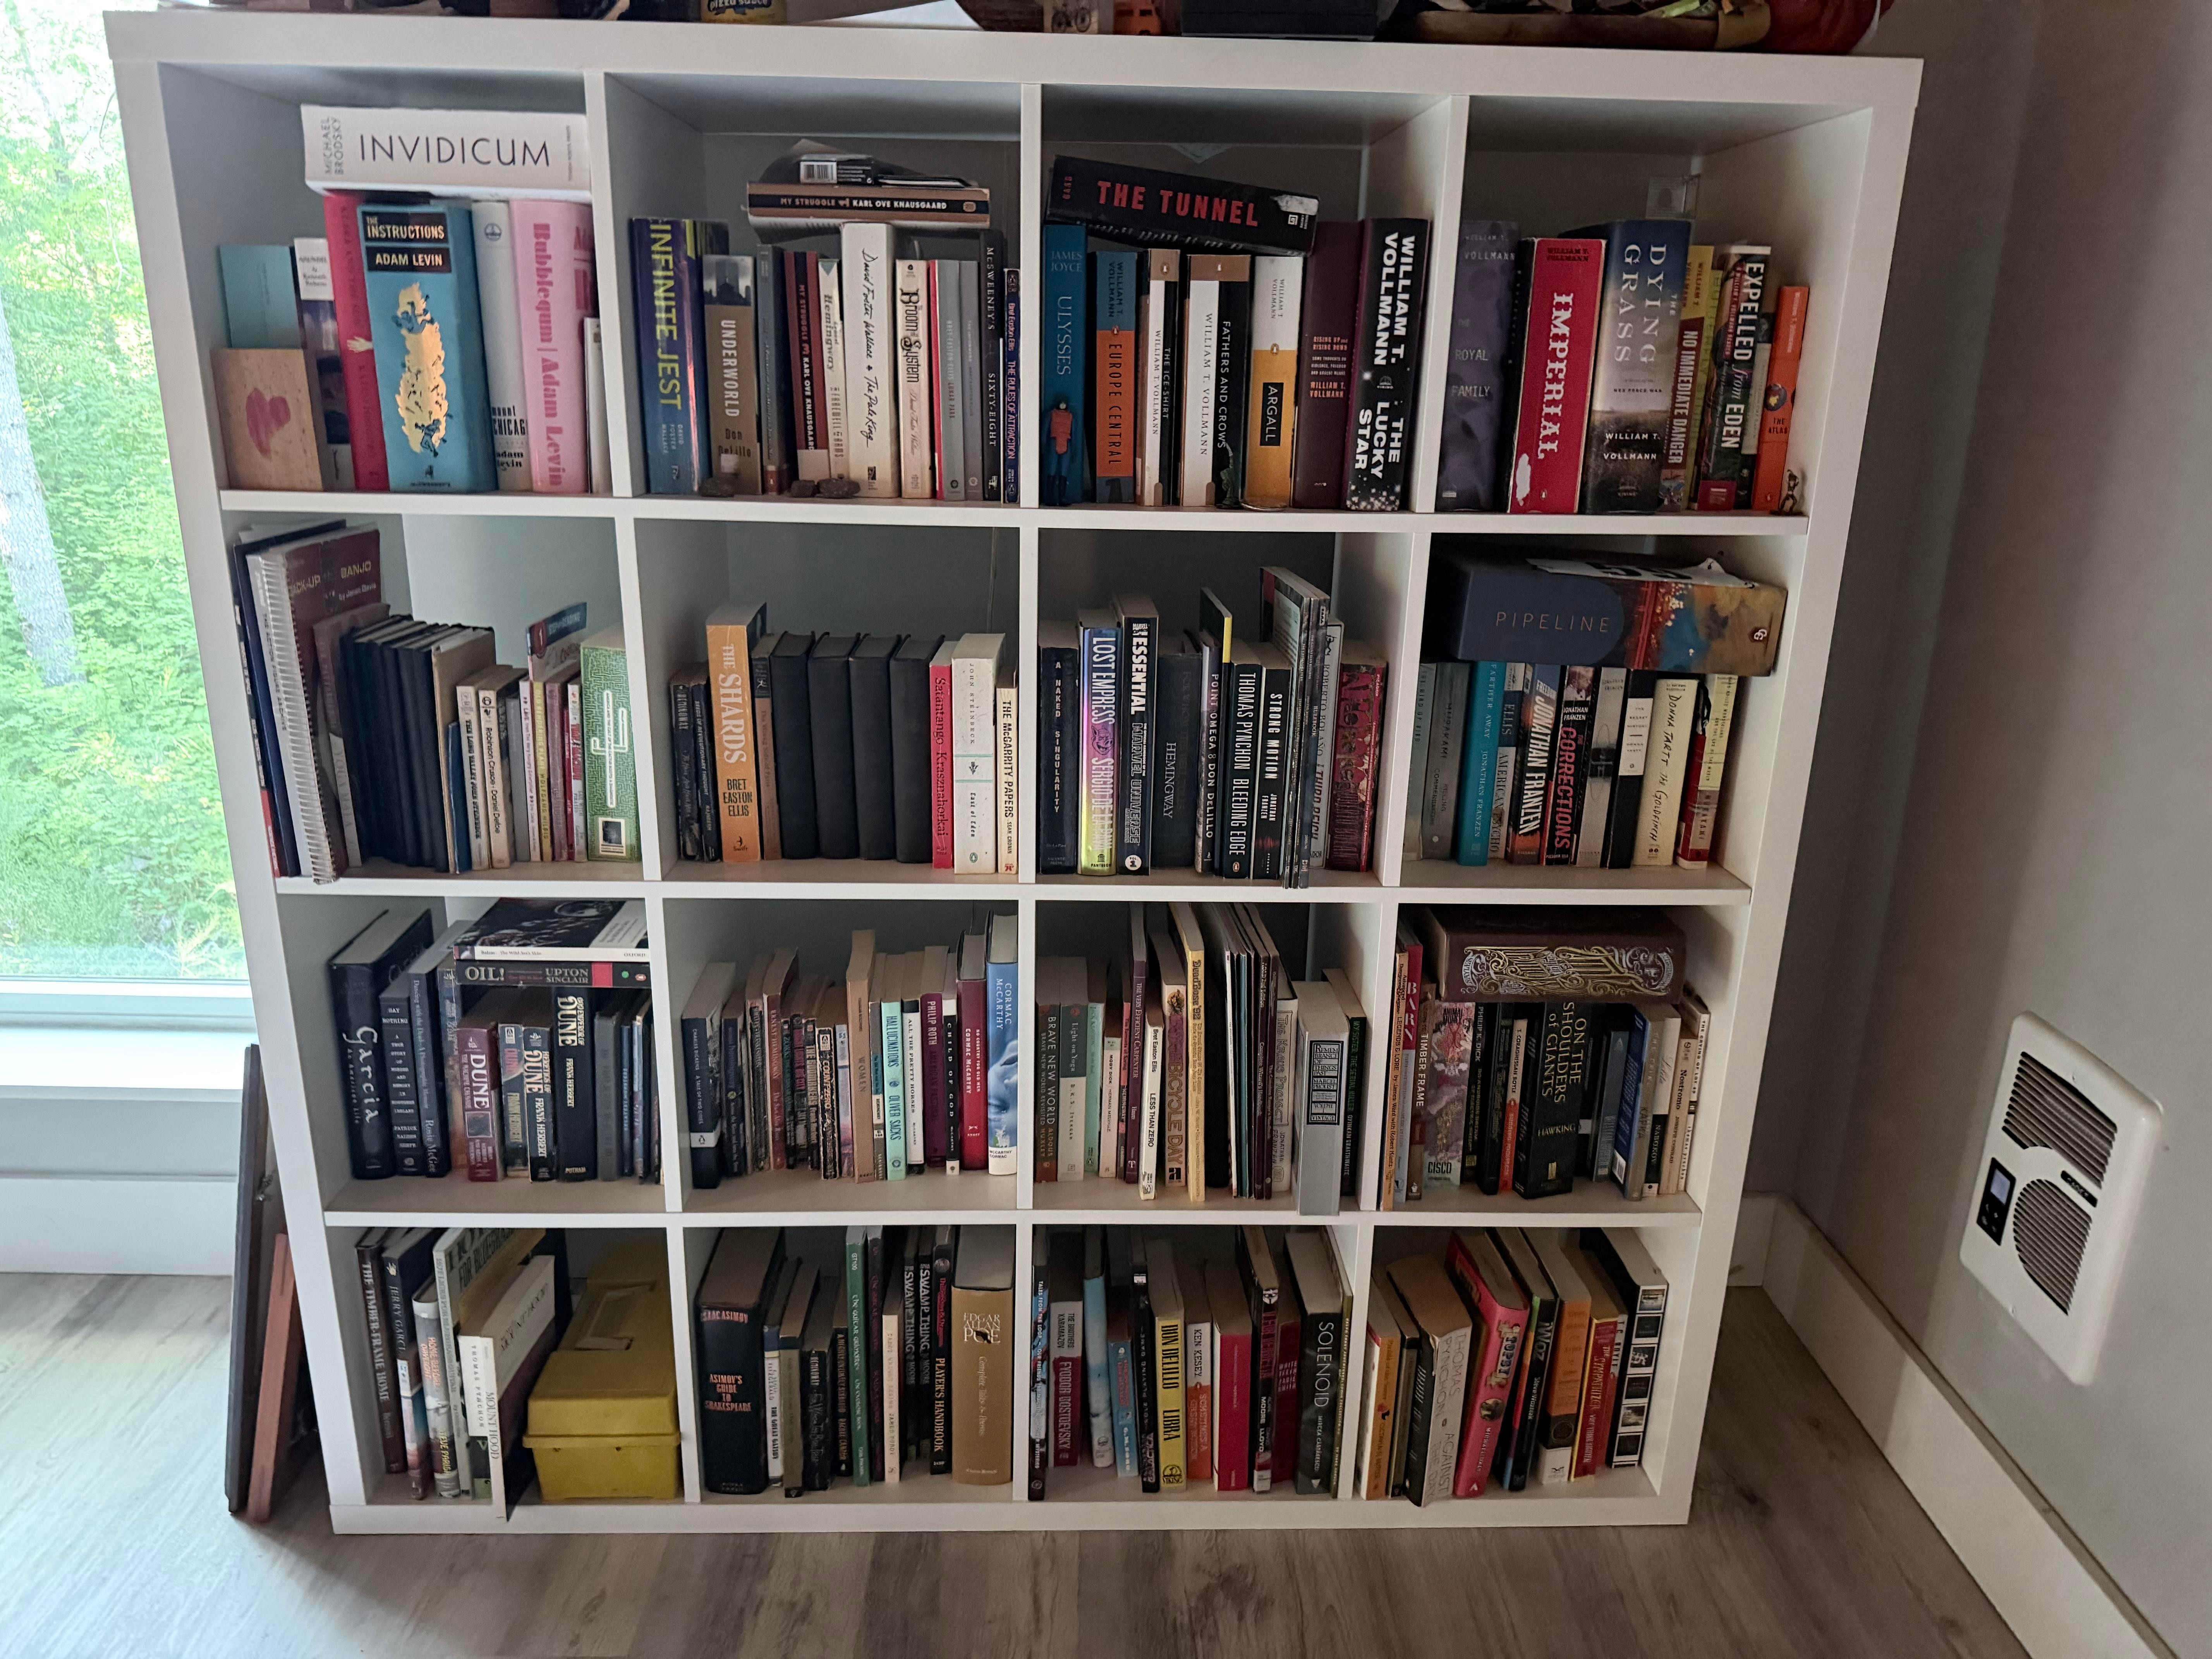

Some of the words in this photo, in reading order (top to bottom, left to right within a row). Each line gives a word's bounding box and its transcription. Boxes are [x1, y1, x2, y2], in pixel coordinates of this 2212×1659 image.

[360, 134, 549, 167] INVIDICUM
[795, 198, 835, 206] STRUGGLE
[894, 200, 947, 210] KNAUSGAARD
[1097, 180, 1147, 210] THE
[1159, 189, 1259, 227] TUNNEL
[368, 225, 445, 239] INSTRUCTIONS
[376, 253, 409, 266] ADAM
[412, 254, 442, 266] LEVIN
[533, 223, 554, 343] Bubblegum
[650, 225, 677, 340] INFINITE
[1374, 232, 1399, 365] VOLLMANN
[1394, 235, 1415, 336] WILLIAM
[1614, 244, 1641, 362] GRASS
[1640, 244, 1666, 363] DYING
[1733, 263, 1765, 360] EXPELLED
[1057, 297, 1072, 375] ULYSSES
[1220, 321, 1231, 373] FATHERS
[1391, 344, 1405, 364] T.
[1455, 349, 1489, 361] ROYAL
[1682, 331, 1698, 347] NO
[541, 357, 560, 418] Adam
[657, 349, 682, 410] JEST
[721, 320, 740, 417] UNDERWORLD
[1109, 344, 1122, 397] EUROPE
[1537, 292, 1574, 460] IMPERIAL
[1674, 350, 1696, 416] IMMEDIATE
[1732, 364, 1748, 400] from
[1219, 378, 1228, 402] AND
[1218, 407, 1227, 448] CROWS
[1266, 385, 1278, 441] ARGALL
[1721, 404, 1745, 448] EDEN
[1109, 405, 1122, 464] CENTRAL
[1355, 409, 1372, 469] STAR
[1370, 402, 1389, 479] LUCKY
[1388, 417, 1404, 463] THE
[1668, 419, 1688, 464] DANGER
[546, 426, 565, 486] Levin
[340, 561, 372, 579] BANJO
[1496, 611, 1610, 632] PIPELINE
[723, 644, 735, 669] THE
[1092, 637, 1116, 669] LOST
[1131, 637, 1148, 715] ESSENTIAL
[1237, 673, 1256, 718] THOMAS
[719, 673, 747, 764] SHARDS
[1002, 701, 1011, 719] THE
[1091, 672, 1116, 725] EMPRESS
[1268, 694, 1283, 733] STRONG
[1668, 694, 1682, 727] DONNA
[1502, 704, 1515, 735] ELLIS
[1527, 696, 1554, 767] JONATHAN
[1131, 723, 1143, 776] MARVEL
[1234, 721, 1253, 770] PYNCHON
[1265, 740, 1279, 779] MOTION
[1664, 731, 1674, 768] TARTT
[727, 779, 747, 790] BRET
[1091, 757, 1115, 797] SERGIO
[1163, 742, 1176, 819] HEMINGWAY
[1554, 727, 1577, 849] CORRECTIONS
[723, 792, 752, 803] EASTON
[728, 805, 749, 816] ELLIS
[1004, 781, 1014, 818] PAPERS
[1129, 779, 1142, 844] UNIVERSE
[1230, 779, 1249, 827] BLEEDING
[1519, 773, 1546, 835] FRANZEN
[1650, 790, 1668, 842] GOLDFINCH
[1229, 831, 1246, 855] EDGE
[465, 967, 504, 981] OIL!
[545, 968, 588, 977] UPTON
[557, 995, 578, 1046] DUNE
[1134, 1009, 1143, 1039] EFFICIENT
[1405, 982, 1417, 1042] BARN
[1549, 1013, 1559, 1028] of
[1575, 1018, 1587, 1044] ON
[1048, 1017, 1056, 1050] BRAVE
[1419, 1033, 1428, 1071] TIMBER
[1554, 1002, 1574, 1103] SHOULDERS
[524, 1050, 543, 1094] DUNE
[948, 1070, 953, 1084] OF
[1047, 1055, 1056, 1080] NEW
[1133, 1041, 1142, 1078] CARPENTER
[1542, 1035, 1558, 1097] GIANTS
[1569, 1050, 1583, 1085] THE
[470, 1054, 489, 1109] DUNE
[1167, 1065, 1183, 1132] BICYCLE
[1416, 1073, 1427, 1107] FRAME
[1047, 1086, 1055, 1125] WORLD
[1168, 1135, 1183, 1165] DAY
[1538, 1124, 1575, 1137] HAWKING
[1428, 1162, 1452, 1174] CISCO
[362, 1262, 374, 1285] THE
[365, 1288, 386, 1370] TIMBER-FRAME
[963, 1313, 1000, 1322] EDGAR
[964, 1321, 1000, 1329] ALLAN
[1161, 1324, 1178, 1349] DON
[709, 1374, 743, 1384] ASIMOV'S
[934, 1358, 945, 1398] PLAYER'S
[1059, 1362, 1072, 1393] FYODOR
[1161, 1351, 1179, 1389] DELILLO
[1314, 1321, 1334, 1407] SOLENOID
[1434, 1336, 1452, 1419] PYNCHON
[1452, 1332, 1467, 1396] THOMAS
[1589, 1356, 1606, 1410] SYMPATHIZER
[376, 1372, 390, 1402] HOME
[716, 1384, 737, 1393] GUIDE
[1532, 1377, 1541, 1394] Steve
[476, 1386, 484, 1428] PYNCHON
[486, 1391, 498, 1427] MOUNT
[705, 1401, 751, 1412] SHAKESPEARE
[933, 1401, 945, 1452] HANDBOOK
[1058, 1396, 1072, 1449] DOSTOEVSKY
[1163, 1409, 1180, 1441] LIBRA
[1528, 1394, 1538, 1420] Wozniak
[489, 1429, 500, 1460] HOOD
[1438, 1433, 1455, 1493] AGAINST
